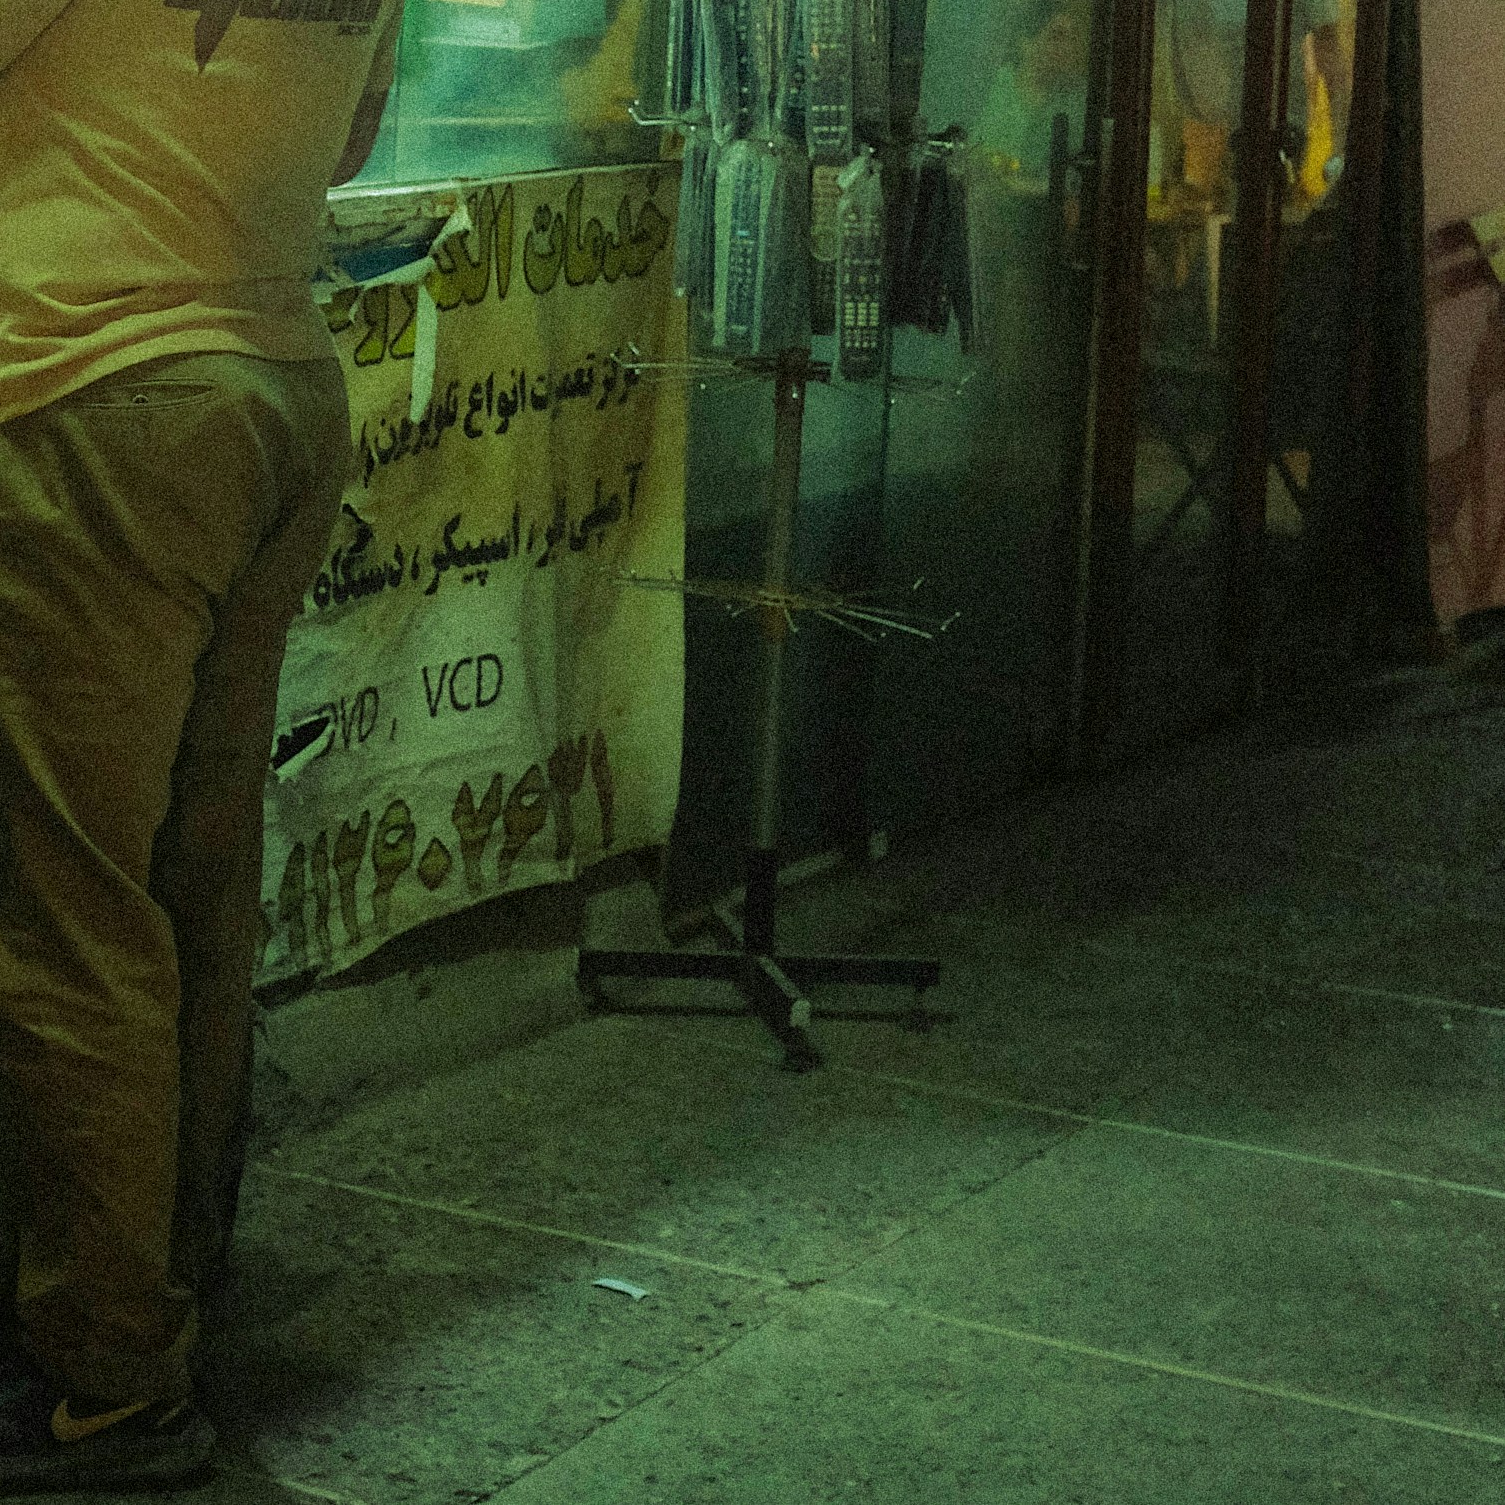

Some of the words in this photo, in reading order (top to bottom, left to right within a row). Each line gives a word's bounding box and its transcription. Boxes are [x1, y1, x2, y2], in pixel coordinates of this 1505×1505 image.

[523, 170, 672, 295] خدمات
[463, 367, 527, 440] انواع
[421, 652, 504, 719] VCD
